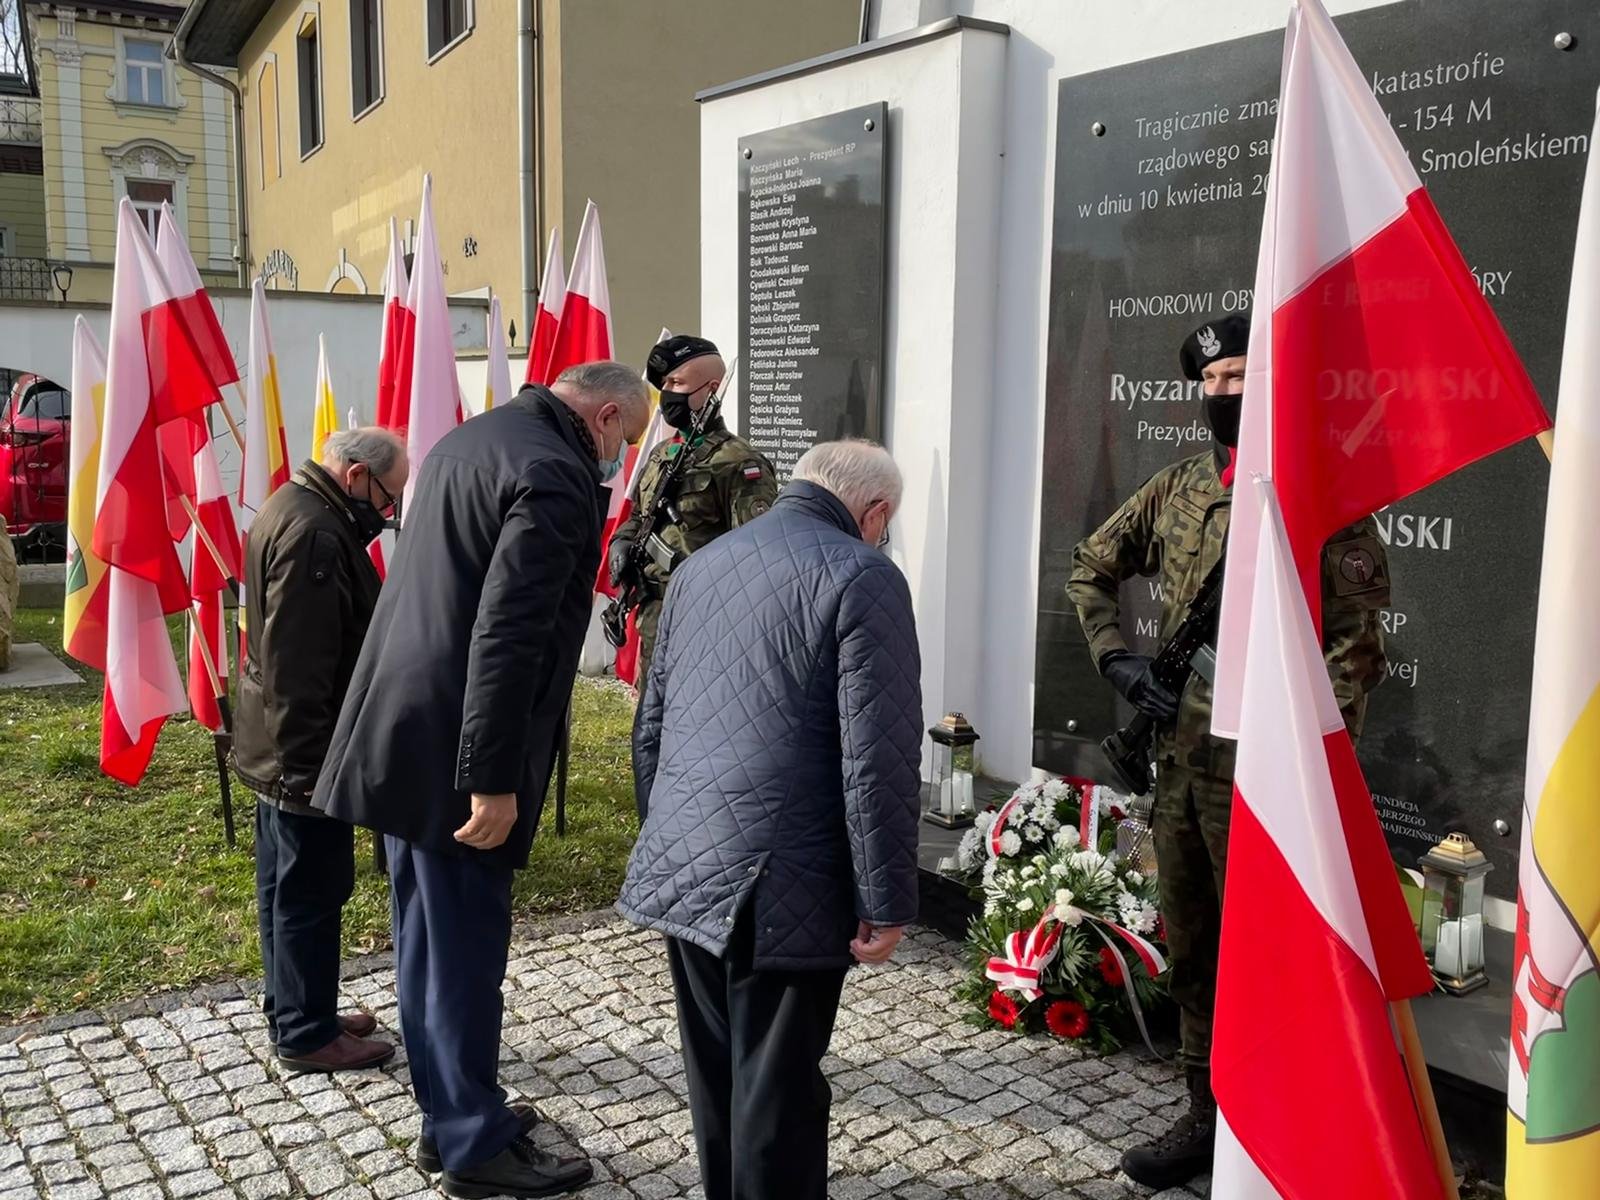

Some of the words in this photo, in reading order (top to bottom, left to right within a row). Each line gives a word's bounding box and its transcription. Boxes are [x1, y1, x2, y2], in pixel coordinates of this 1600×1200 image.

[1372, 51, 1505, 96] katastrofie
[1467, 97, 1491, 123] M
[1135, 104, 1229, 141] Tragicznie
[1237, 98, 1280, 120] zma
[1138, 143, 1240, 176] rządowego
[1249, 138, 1275, 158] sa
[1421, 133, 1588, 174] Smoleńskiem
[783, 193, 796, 203] Ewa
[1078, 203, 1092, 218] w
[1097, 194, 1132, 216] dniu
[1139, 189, 1158, 210] 10
[1166, 177, 1243, 207] kwietnia
[764, 255, 789, 265] Tadeusz
[791, 263, 810, 273] Miron
[774, 288, 796, 299] Leszek
[772, 300, 800, 312] Zbigniew
[1109, 292, 1213, 318] HONOROWI
[773, 313, 800, 323] Grzegorz
[788, 324, 820, 334] Katarzyna
[787, 334, 811, 345] Edward
[784, 346, 819, 356] Aleksander
[774, 382, 791, 391] Artur
[770, 393, 802, 402] Franciszek
[777, 450, 798, 460] Robert
[1136, 617, 1158, 638] Mi
[1379, 610, 1407, 634] RP
[1372, 793, 1420, 812] FUNDACJA
